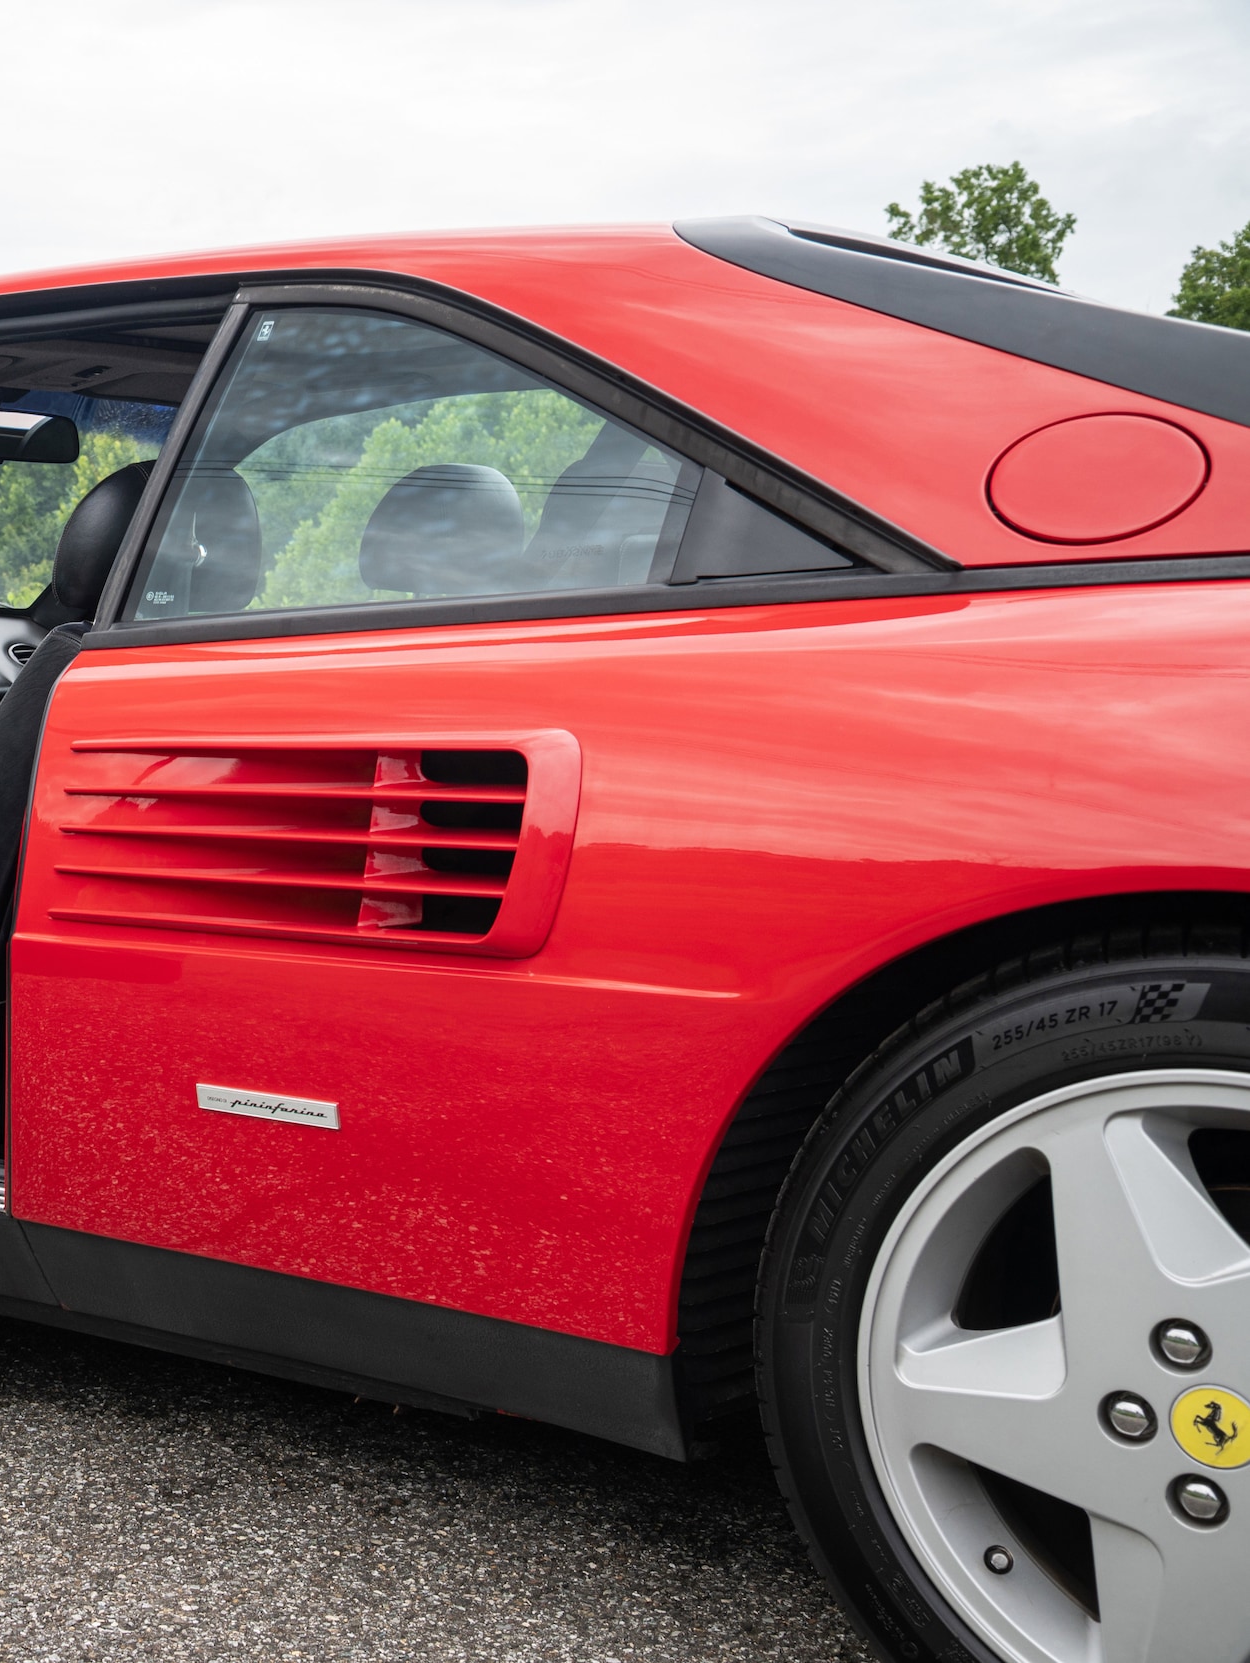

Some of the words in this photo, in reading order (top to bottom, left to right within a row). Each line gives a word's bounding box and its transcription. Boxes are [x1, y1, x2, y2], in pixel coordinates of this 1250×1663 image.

[992, 1013, 1059, 1050] 255/45
[1064, 1006, 1091, 1024] ZR
[1098, 1001, 1118, 1017] 17
[230, 1099, 328, 1118] pininfarina
[810, 1049, 962, 1247] MICHELIN
